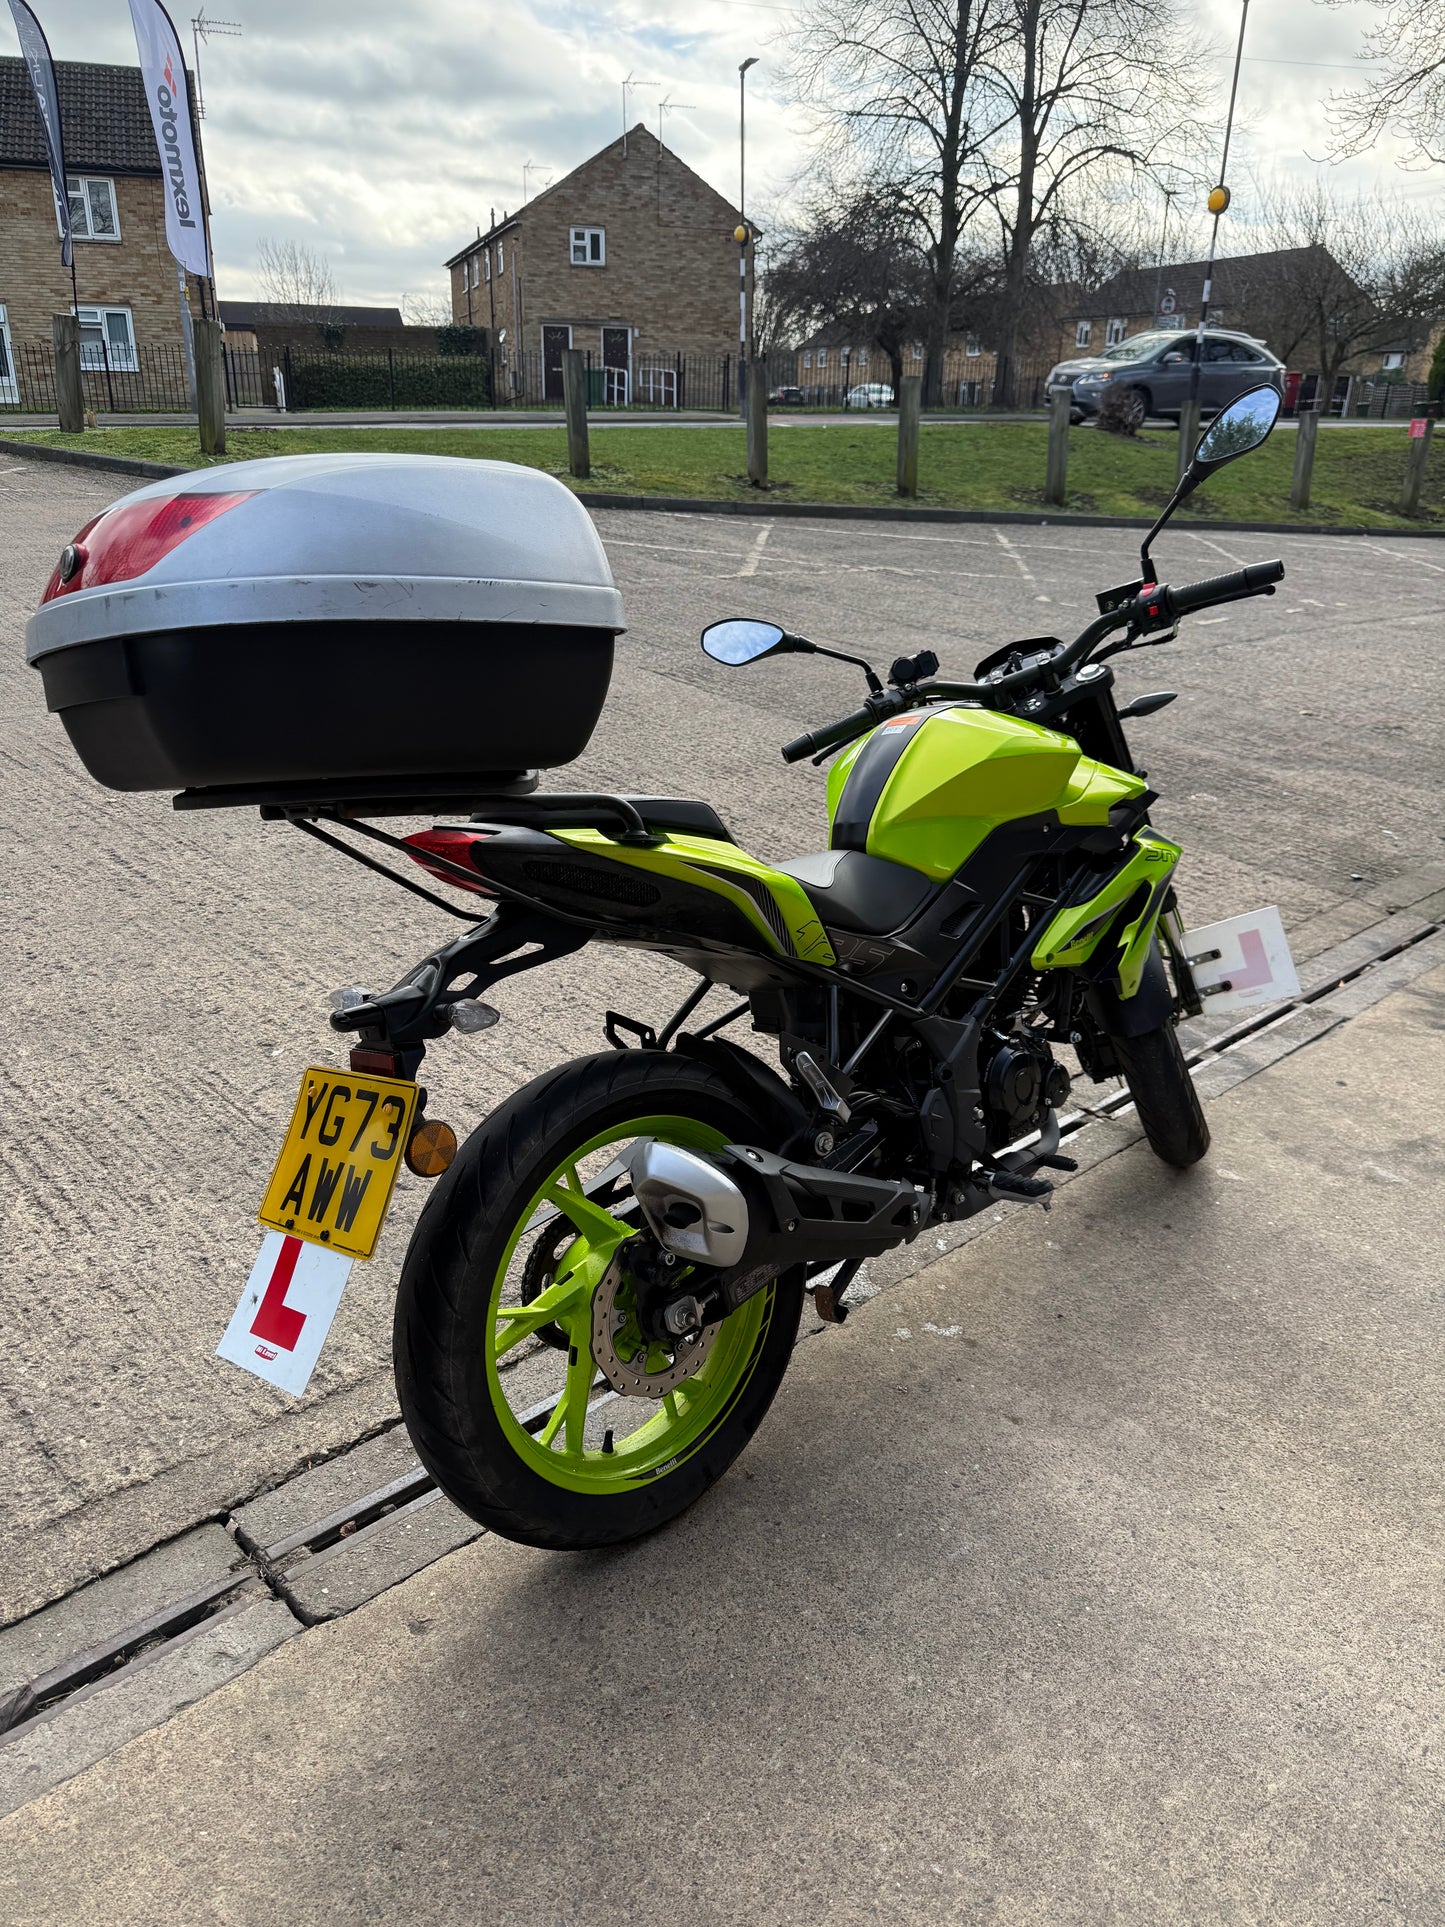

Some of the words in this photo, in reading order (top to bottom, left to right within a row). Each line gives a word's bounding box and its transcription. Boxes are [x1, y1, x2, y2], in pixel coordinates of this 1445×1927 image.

[300, 1079, 406, 1161] YG73
[279, 1153, 374, 1233] AWW
[249, 1234, 308, 1353] L
[655, 1457, 678, 1475] Benelli
